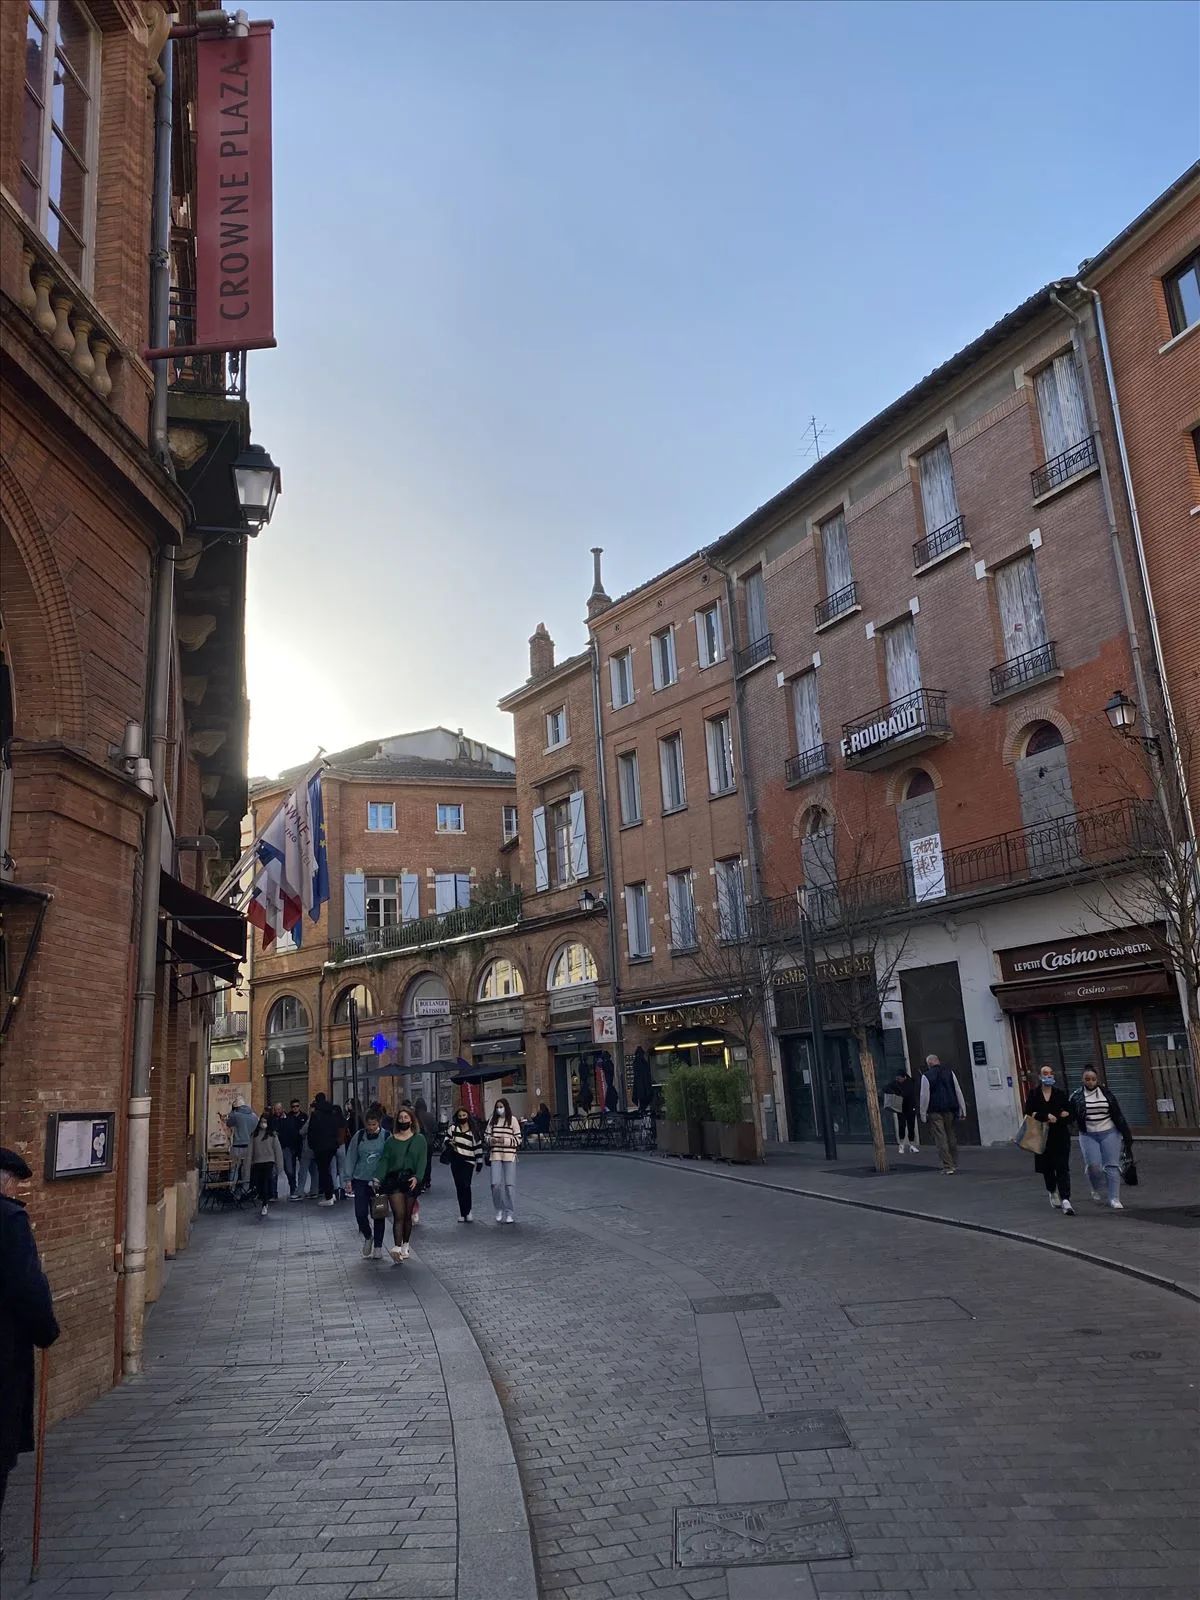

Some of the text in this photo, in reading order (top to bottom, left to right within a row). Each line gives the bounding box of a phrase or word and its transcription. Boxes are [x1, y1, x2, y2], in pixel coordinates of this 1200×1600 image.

[220, 58, 249, 321] CROWNE PLAZA
[284, 828, 297, 843] IHG
[1014, 963, 1022, 973] LE
[1041, 947, 1098, 971] Casino
[1099, 949, 1108, 959] DE
[1109, 943, 1152, 957] GAMBETTA
[1077, 985, 1105, 996] Casino
